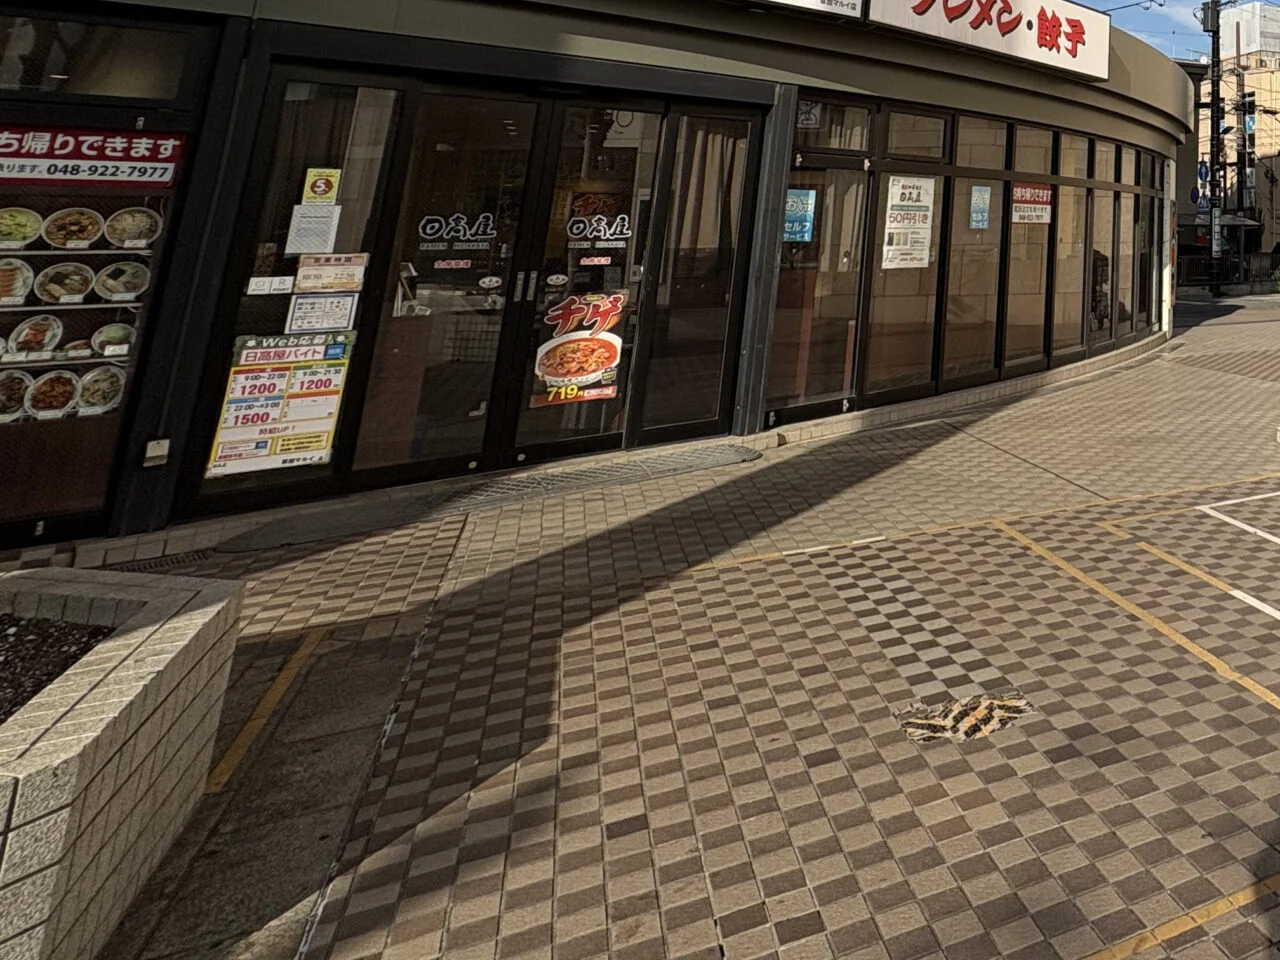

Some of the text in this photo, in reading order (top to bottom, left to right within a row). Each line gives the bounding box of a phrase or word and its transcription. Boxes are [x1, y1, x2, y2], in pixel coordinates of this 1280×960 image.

[46, 163, 169, 179] 048-922-7977
[888, 212, 929, 224] 50円引き
[419, 213, 497, 240] 日高屋
[566, 214, 632, 240] 日高屋
[784, 222, 810, 232] セルフ
[543, 295, 623, 338] チゲ
[244, 347, 321, 363] 日高屋バイト
